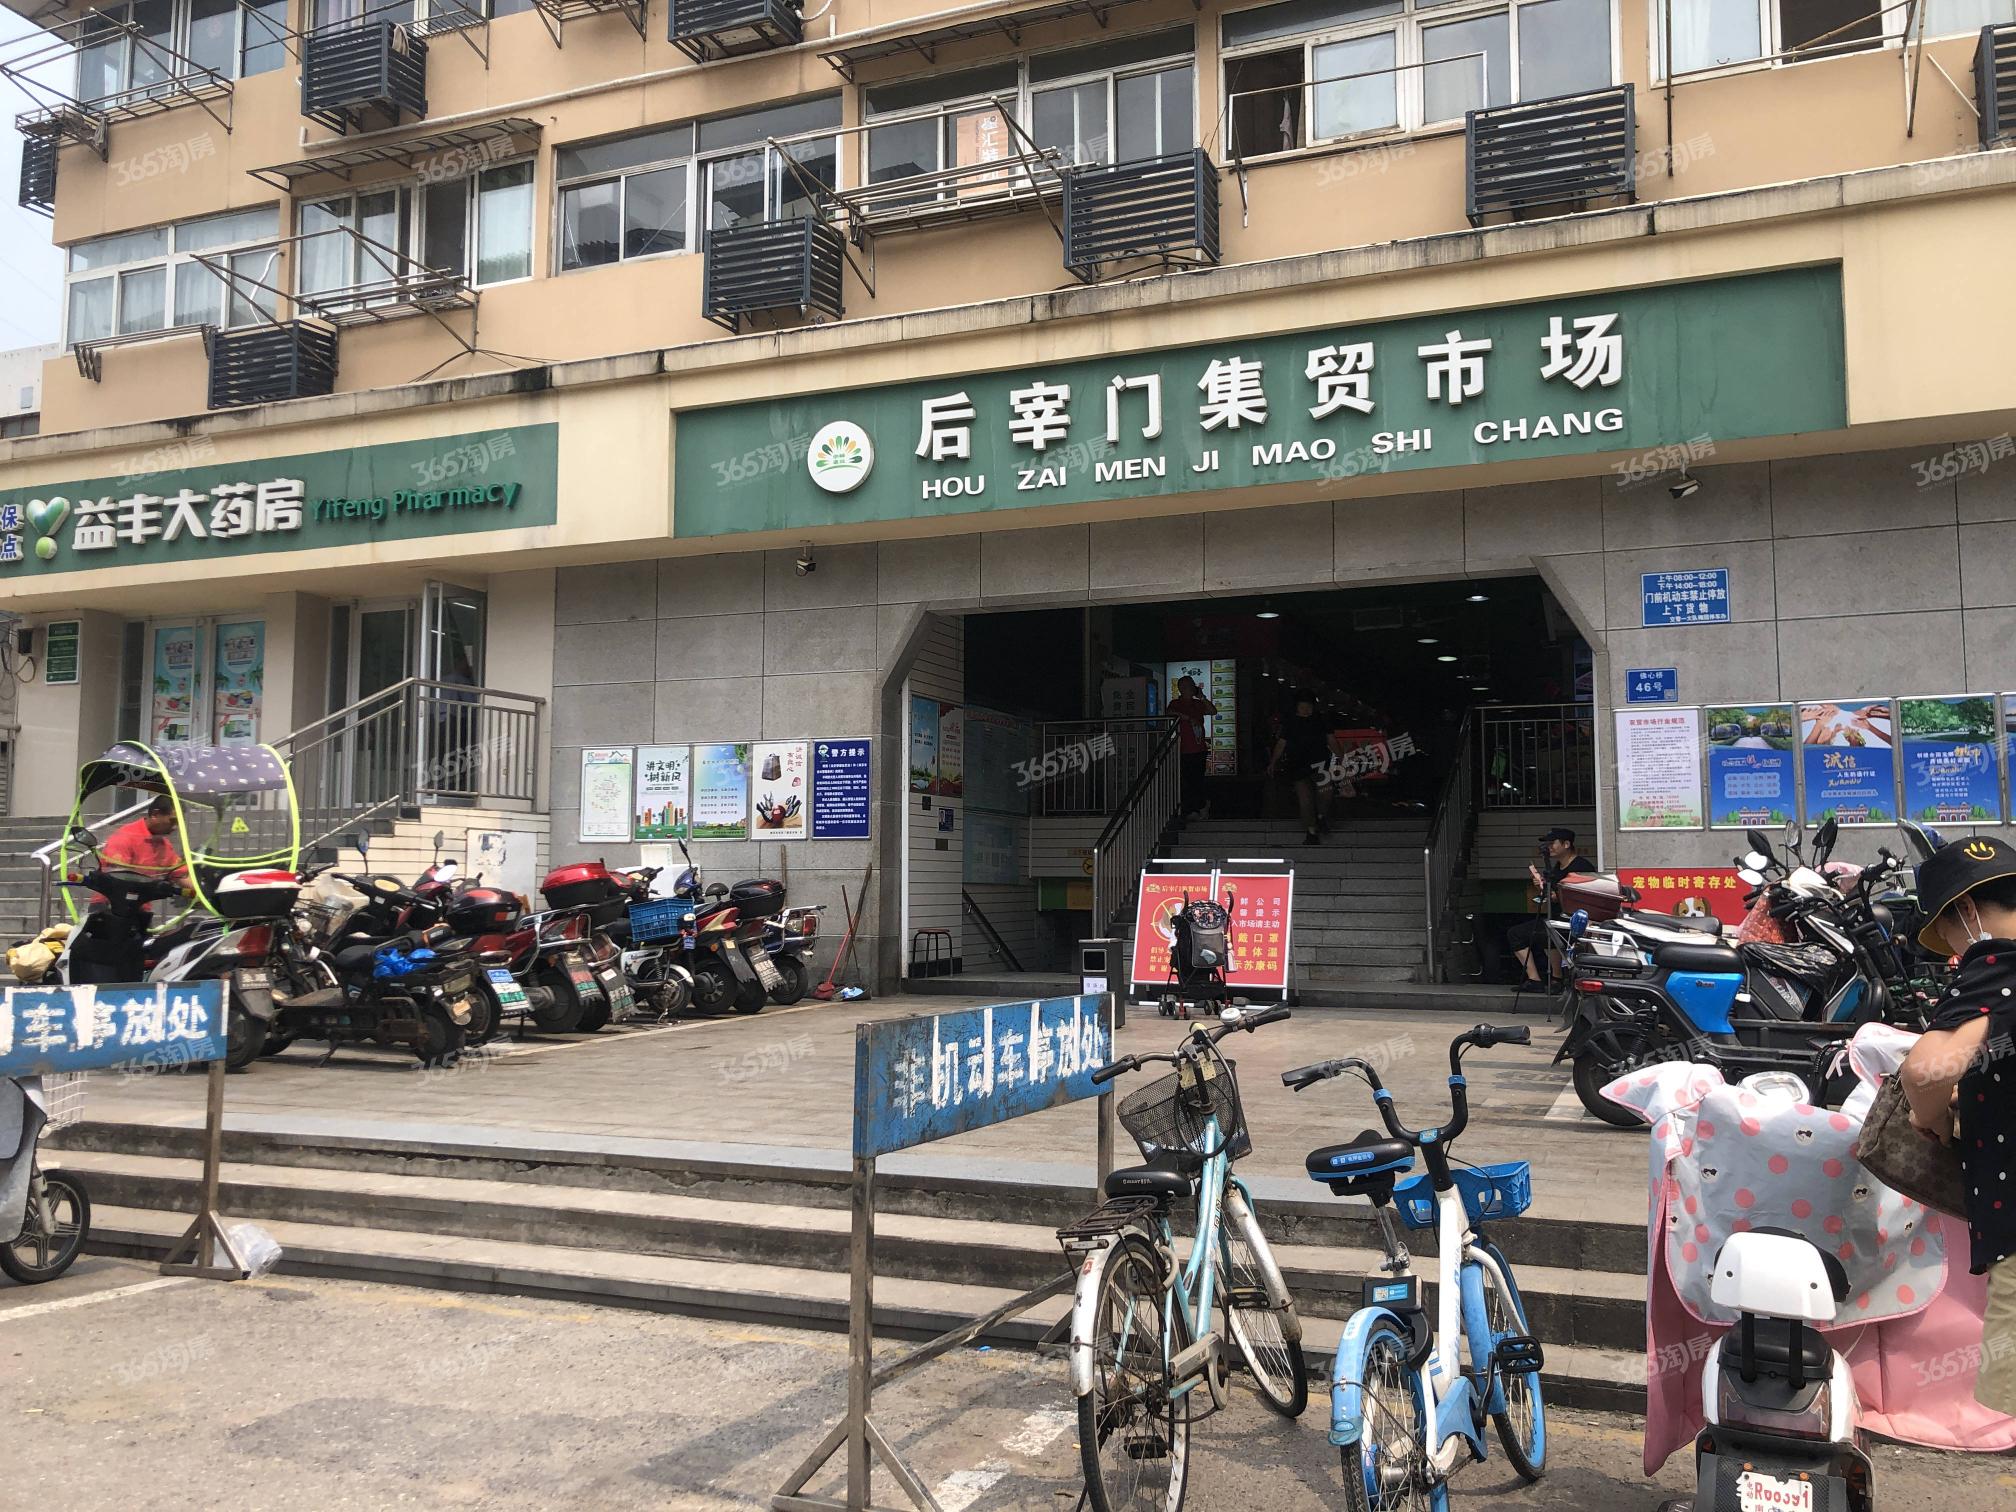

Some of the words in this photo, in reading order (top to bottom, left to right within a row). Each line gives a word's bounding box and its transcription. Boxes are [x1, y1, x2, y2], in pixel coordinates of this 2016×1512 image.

[914, 312, 1624, 462] 后宰门集贸市场
[921, 475, 985, 500] HOU
[1017, 466, 1067, 490] ZAI
[1095, 456, 1166, 483] MEN
[1192, 450, 1219, 473] JI
[1252, 438, 1336, 466] MAO
[1371, 428, 1432, 455] SHI
[1473, 408, 1624, 445] CHANG
[311, 497, 386, 521] Yifeng
[392, 481, 521, 513] Pharmacy
[72, 478, 305, 550] 益丰大药房
[1645, 589, 1726, 604] 门前机动车禁止停放
[1635, 682, 1663, 693] 46号
[831, 748, 865, 758] 警方提示
[646, 760, 675, 771] 讲文明
[1823, 751, 1856, 769] 诚信
[649, 771, 682, 782] 树新风
[1632, 875, 1736, 889] 宠物临时寄存处
[1239, 908, 1280, 917] 馨提示
[1231, 919, 1280, 928] 入市场请主动
[1230, 932, 1279, 943] 戴口罩
[1236, 946, 1278, 957] 量体温
[1234, 960, 1278, 972] 示苏康码
